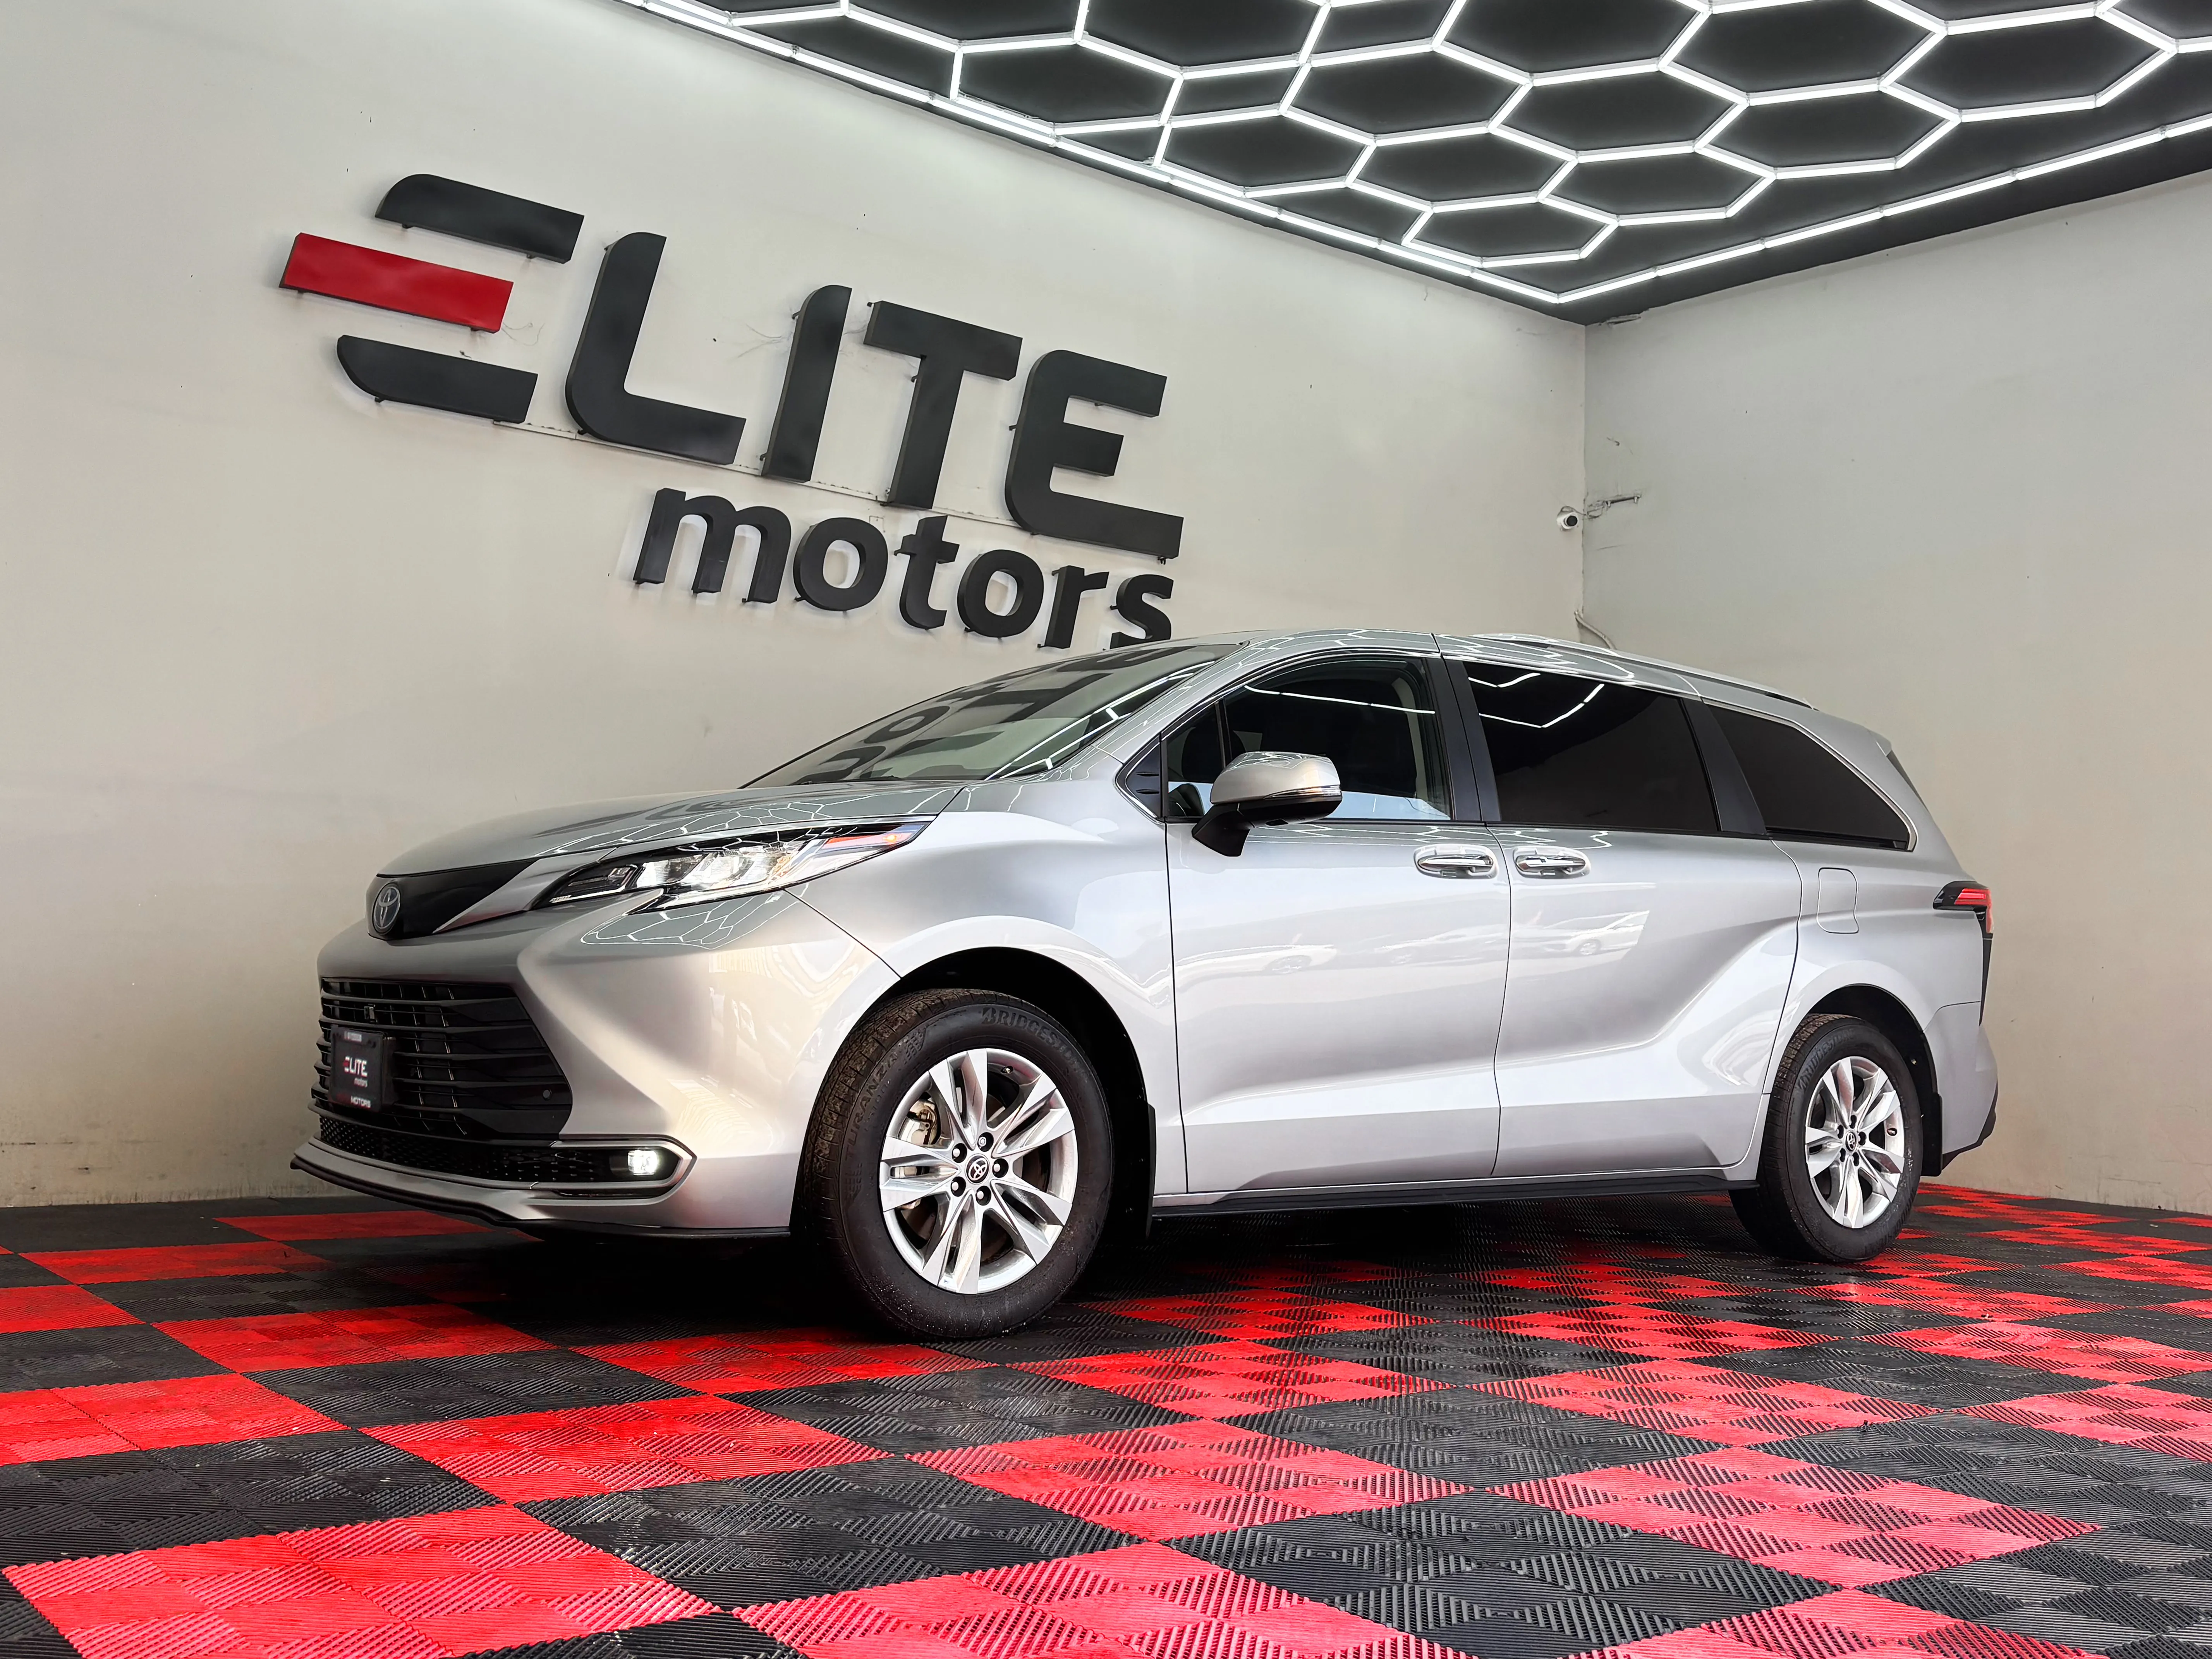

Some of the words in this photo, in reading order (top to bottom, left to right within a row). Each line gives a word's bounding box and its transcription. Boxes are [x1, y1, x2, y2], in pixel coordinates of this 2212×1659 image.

[279, 173, 1184, 561] ELITE
[634, 488, 1174, 651] motors
[343, 1056, 368, 1077] ELITE
[351, 1095, 371, 1108] MOTORS
